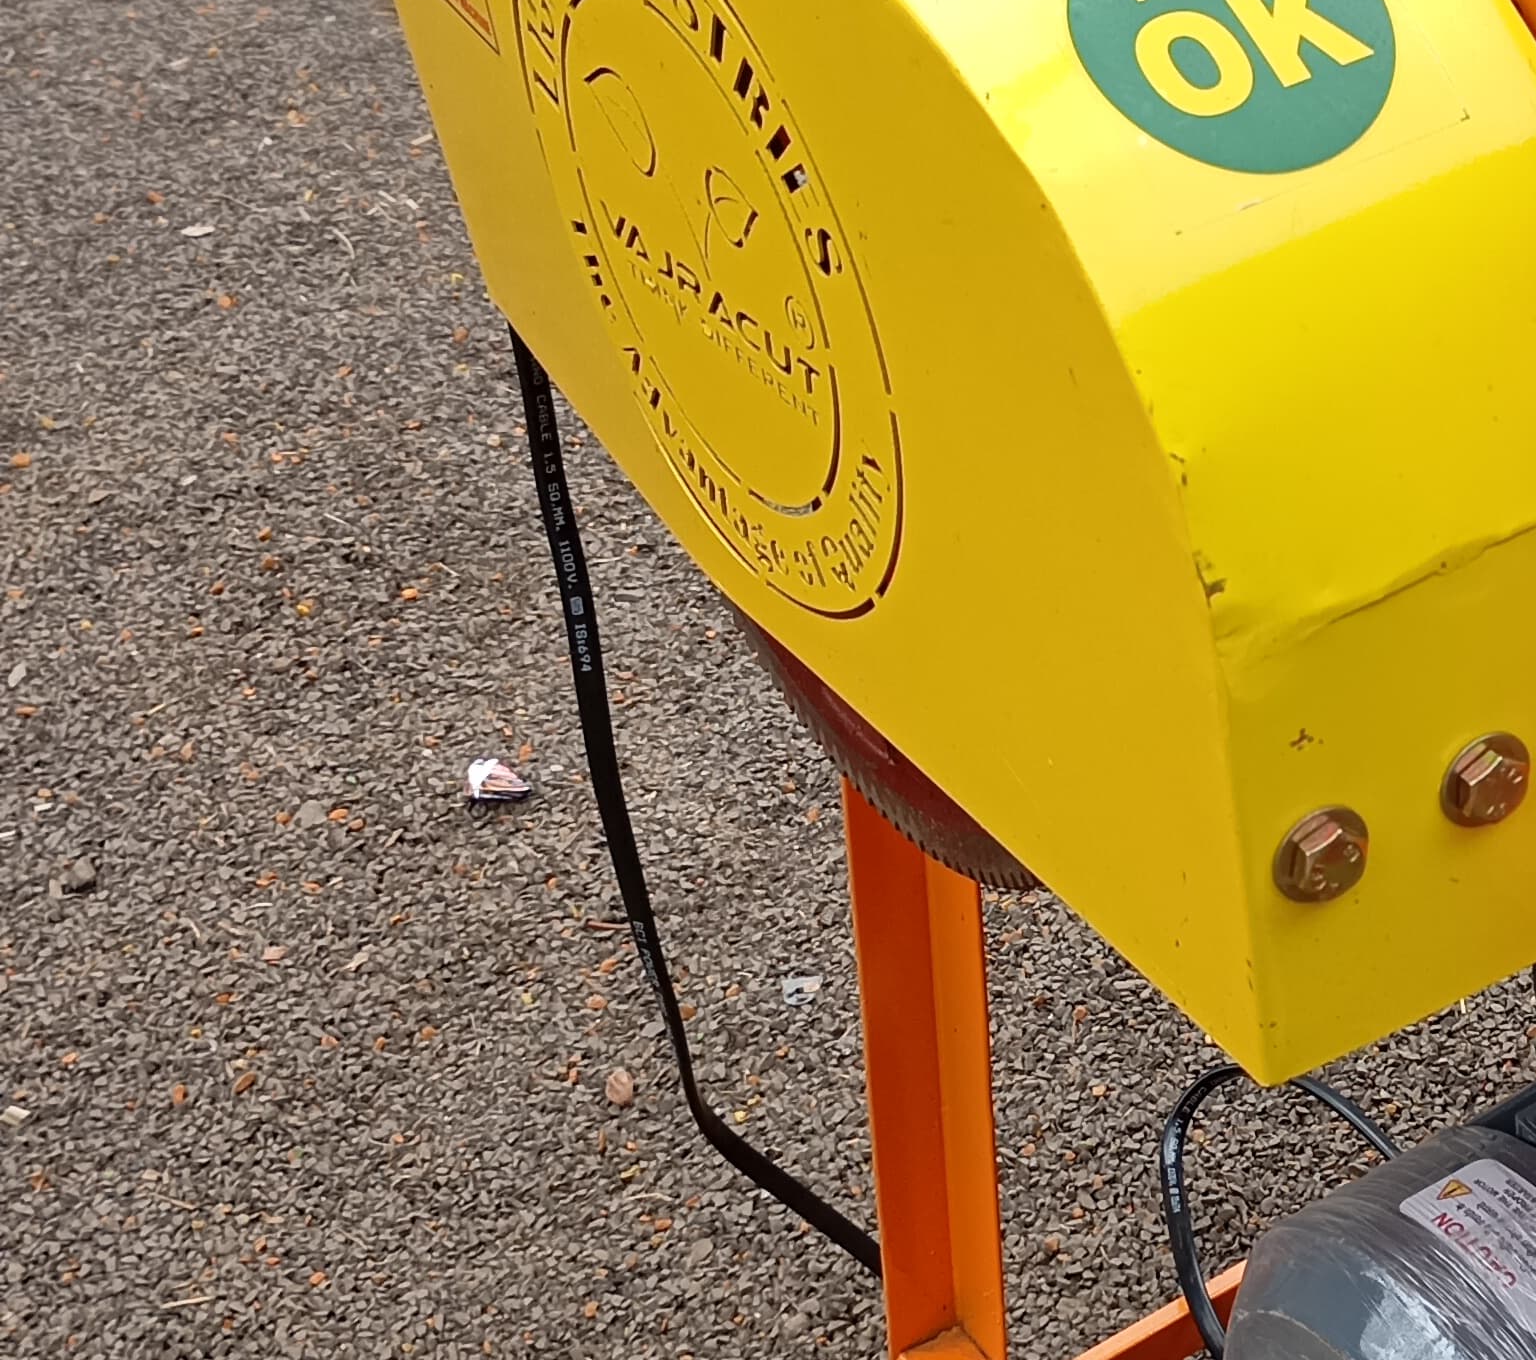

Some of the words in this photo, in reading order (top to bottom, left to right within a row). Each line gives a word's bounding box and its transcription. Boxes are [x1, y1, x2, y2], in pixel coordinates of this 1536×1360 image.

[599, 198, 822, 395] VAJRACUT
[535, 394, 550, 442] CABLE
[542, 451, 554, 475] 1.5
